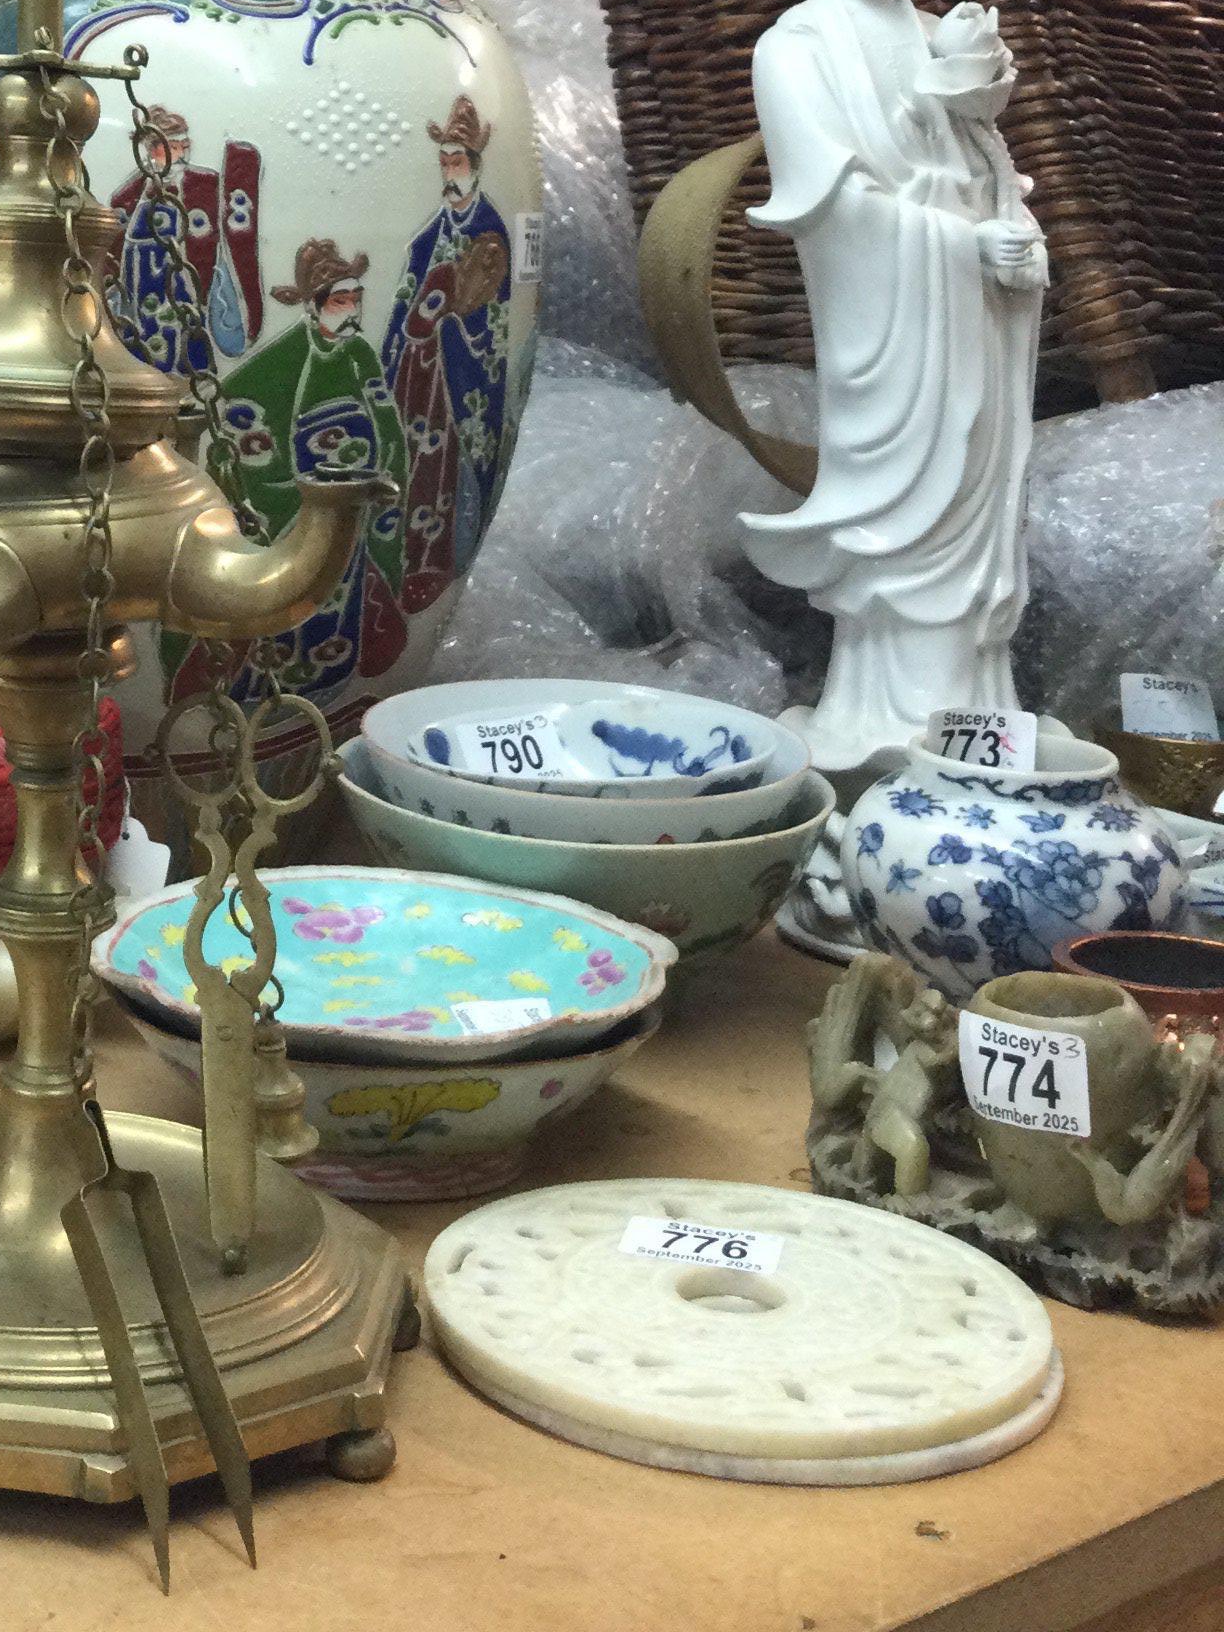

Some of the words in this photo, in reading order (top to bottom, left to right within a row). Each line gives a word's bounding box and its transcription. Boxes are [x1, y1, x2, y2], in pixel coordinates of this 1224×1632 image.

[477, 720, 535, 738] Stacey's
[943, 712, 1006, 729] Stacey's
[481, 735, 543, 773] 790
[941, 729, 1000, 768] 773
[981, 1022, 1060, 1057] Stacey's
[978, 1046, 1061, 1109] 774
[1043, 1113, 1079, 1132] 2025
[662, 1229, 749, 1259] 776
[668, 1222, 756, 1241] Stacey's
[636, 1246, 721, 1265] September
[726, 1260, 762, 1271] 2025
